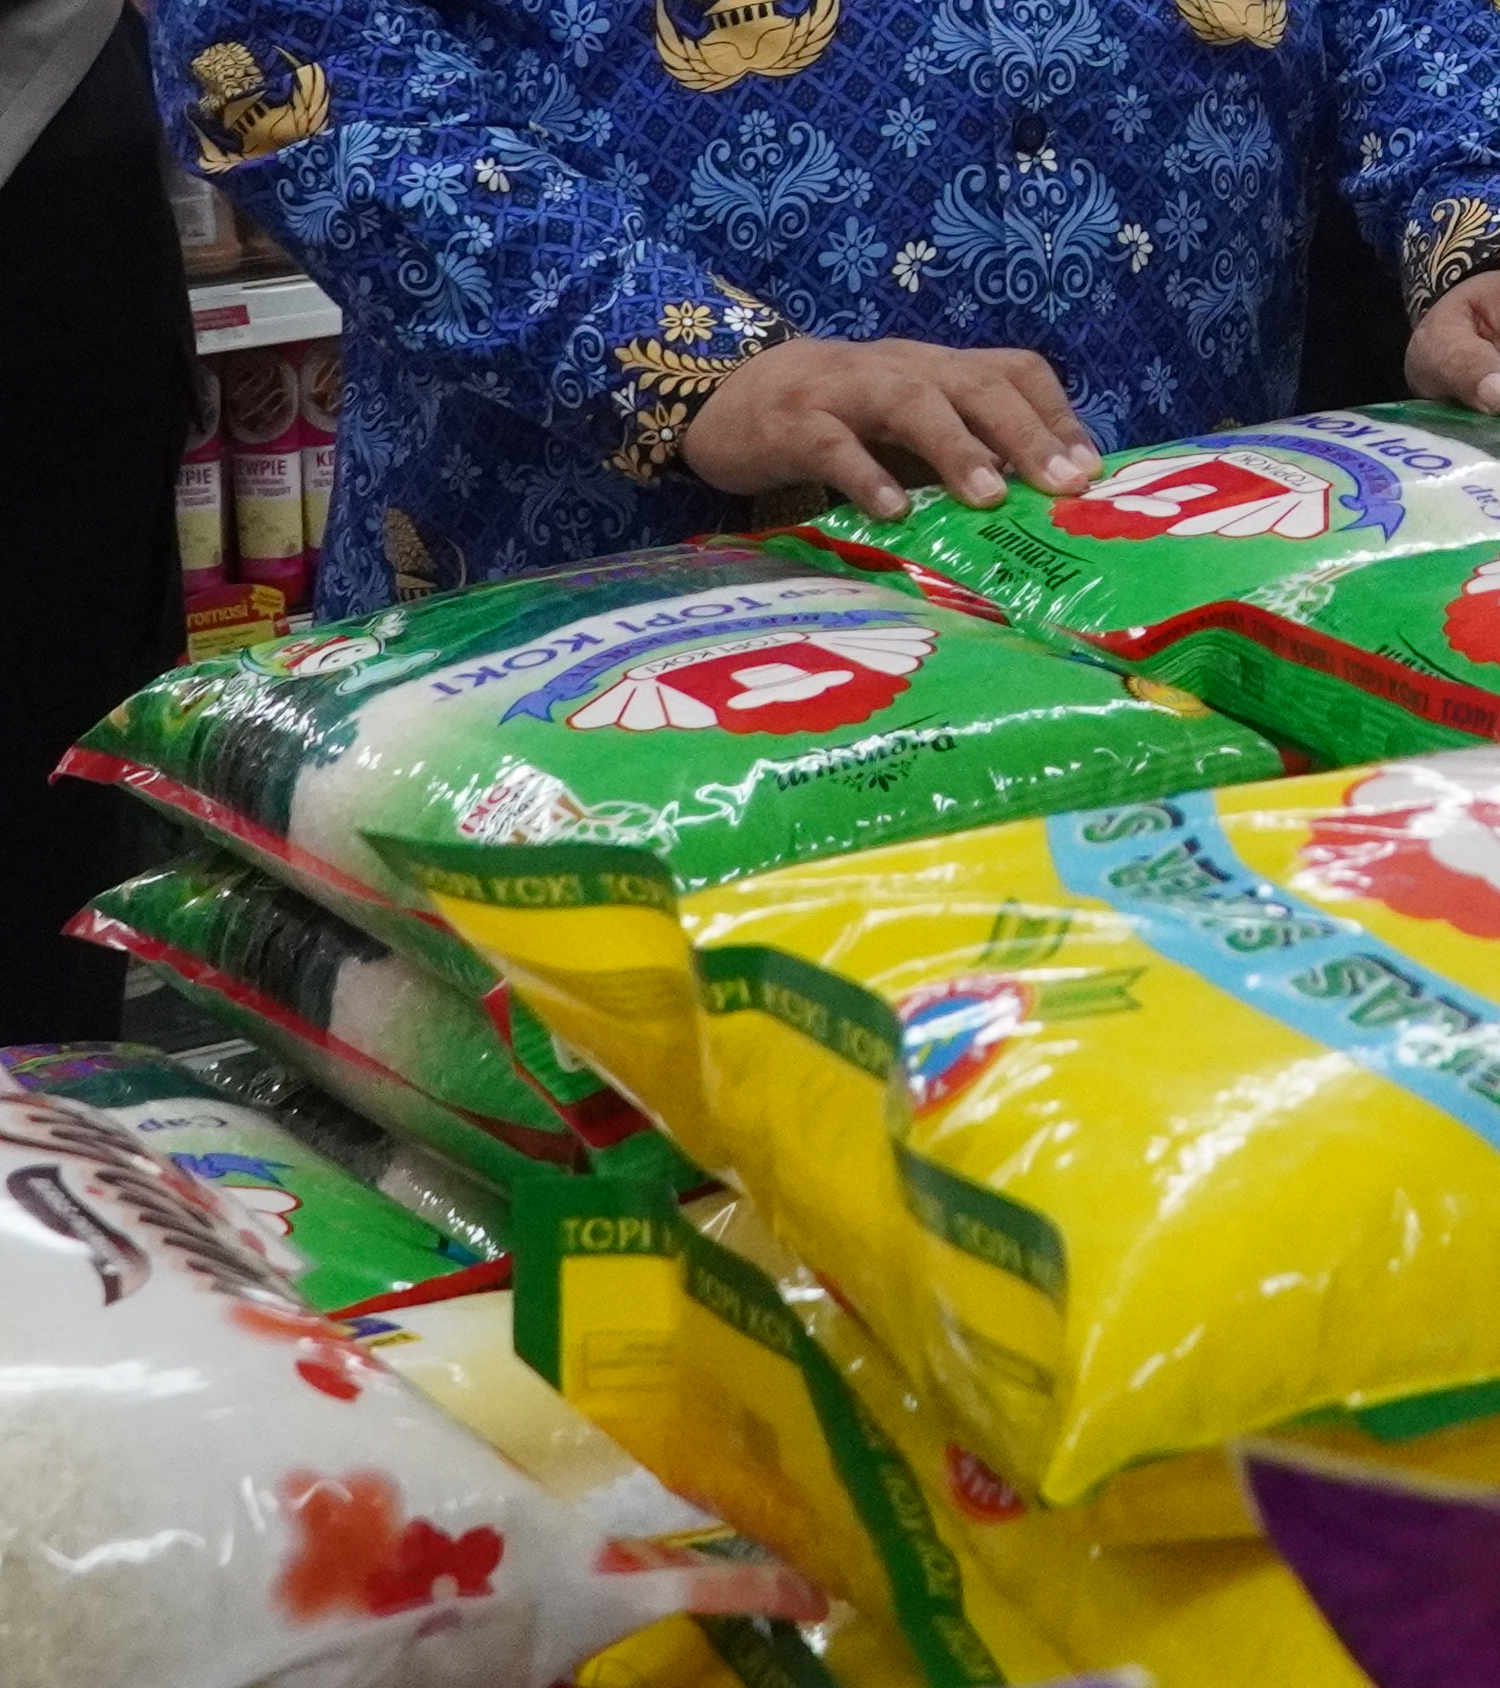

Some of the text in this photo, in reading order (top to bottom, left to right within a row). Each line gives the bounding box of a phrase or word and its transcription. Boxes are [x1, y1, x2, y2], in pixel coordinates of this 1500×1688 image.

[980, 523, 1083, 593] Premium
[778, 584, 863, 602] Cap
[614, 594, 774, 637] TOPI
[430, 629, 607, 704] KOKI
[644, 633, 792, 675] TOPI KOKI
[1441, 696, 1498, 740] TOPI
[562, 1215, 652, 1255] TOPI
